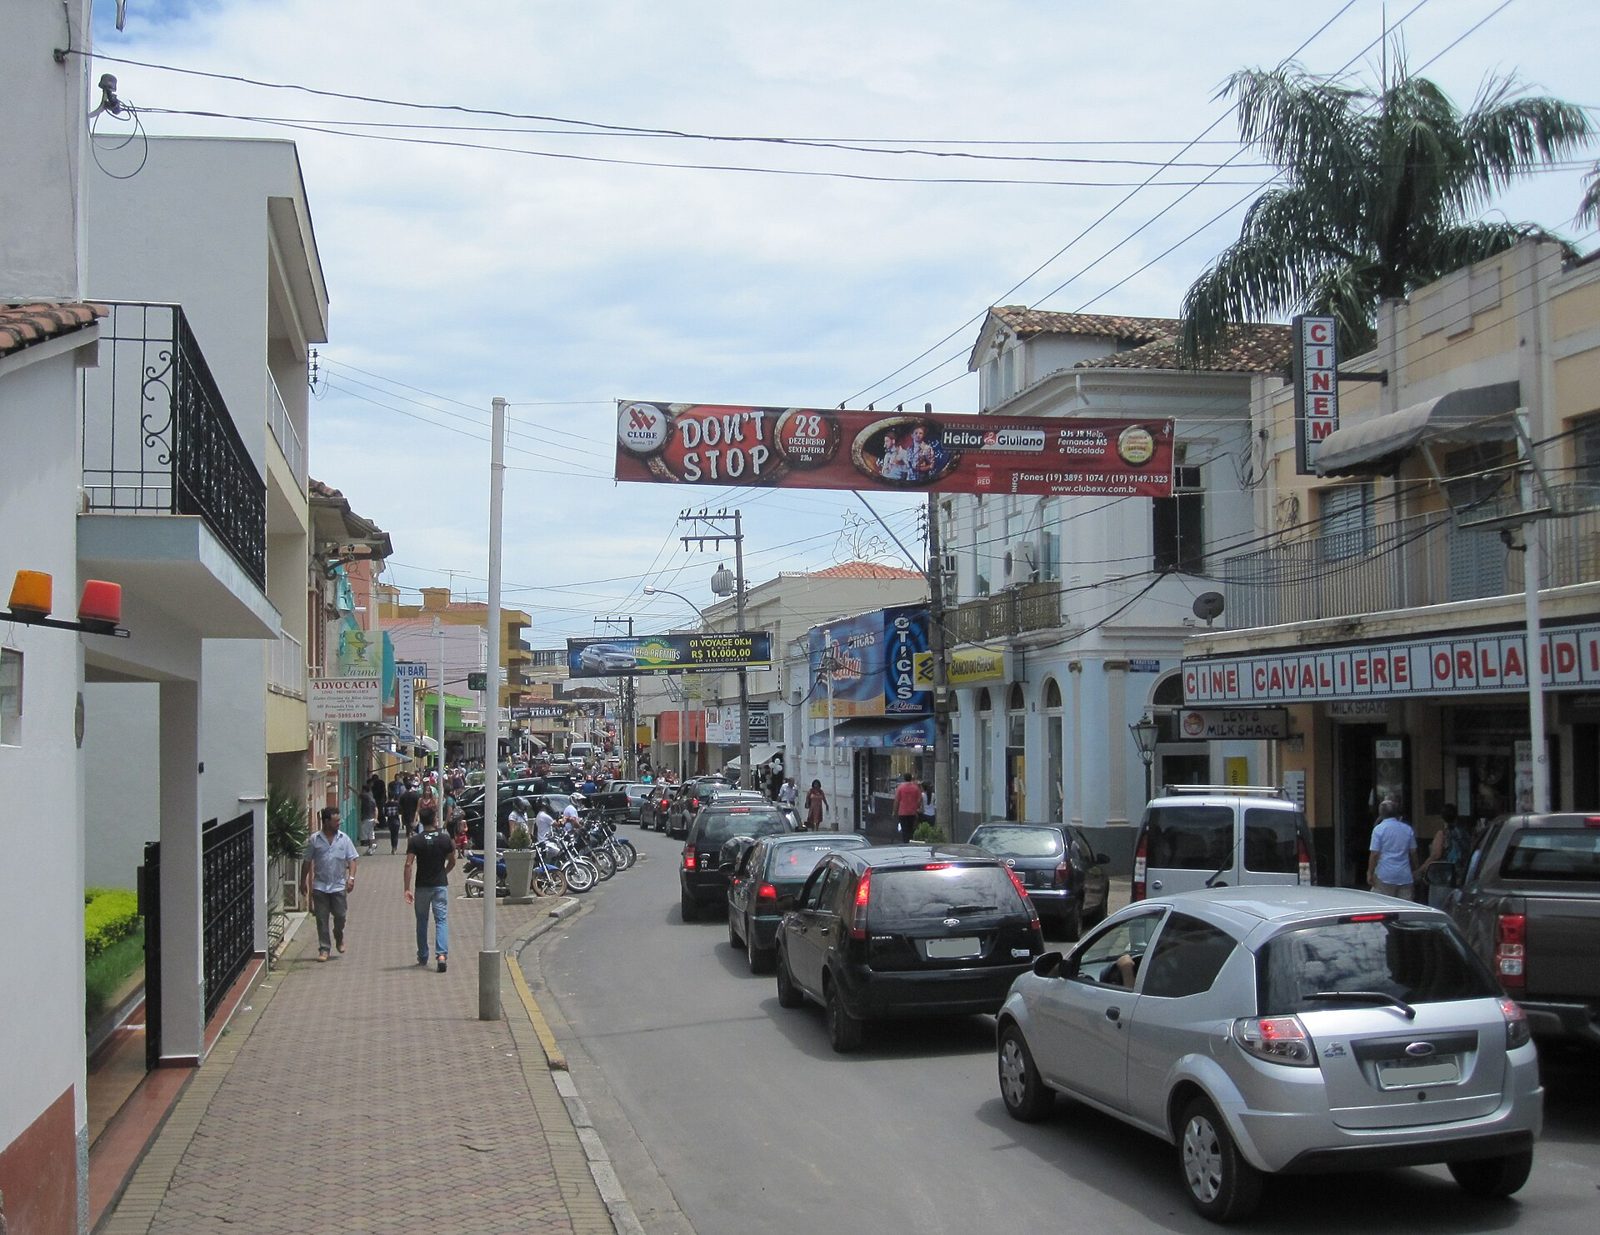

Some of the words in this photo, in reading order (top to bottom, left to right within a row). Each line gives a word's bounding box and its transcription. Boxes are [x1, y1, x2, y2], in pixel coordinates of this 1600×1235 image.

[1310, 324, 1333, 440] CINEM
[678, 411, 764, 448] DON'T
[795, 415, 821, 437] 28
[627, 431, 658, 439] CLUBE
[943, 431, 982, 444] Heitor
[997, 434, 1043, 446] Giuliano
[788, 437, 826, 446] DEZEMBRO
[1057, 438, 1095, 446] Fernando
[1096, 438, 1108, 446] MS
[788, 446, 825, 454] SEXTA-FEIRA
[1066, 446, 1105, 455] Discolado
[683, 445, 769, 481] STOP
[1011, 472, 1019, 493] INFOS
[1020, 472, 1044, 481] Fones
[1045, 473, 1062, 483] (19)
[1063, 473, 1083, 482] 3895
[1085, 474, 1104, 482] 1074
[1111, 474, 1128, 484] (19)
[1129, 475, 1168, 484] 9149.1323
[1051, 485, 1137, 494] www.clubexv.com.br
[700, 638, 733, 647] VOYAGE
[691, 649, 704, 659] R$
[706, 648, 751, 658] 10.000,00
[894, 613, 913, 699] ÓTICAS
[397, 666, 406, 676] NI
[408, 666, 424, 676] BAR
[952, 660, 969, 676] BANCO
[977, 656, 996, 672] BRASIL
[1186, 669, 1237, 695] CINE
[1254, 655, 1408, 692] CAVALIERE
[313, 681, 378, 690] ADVOCACIA
[529, 707, 563, 717] TIGRÃO
[1207, 724, 1234, 736] MILK
[1238, 724, 1279, 736] SHAKE
